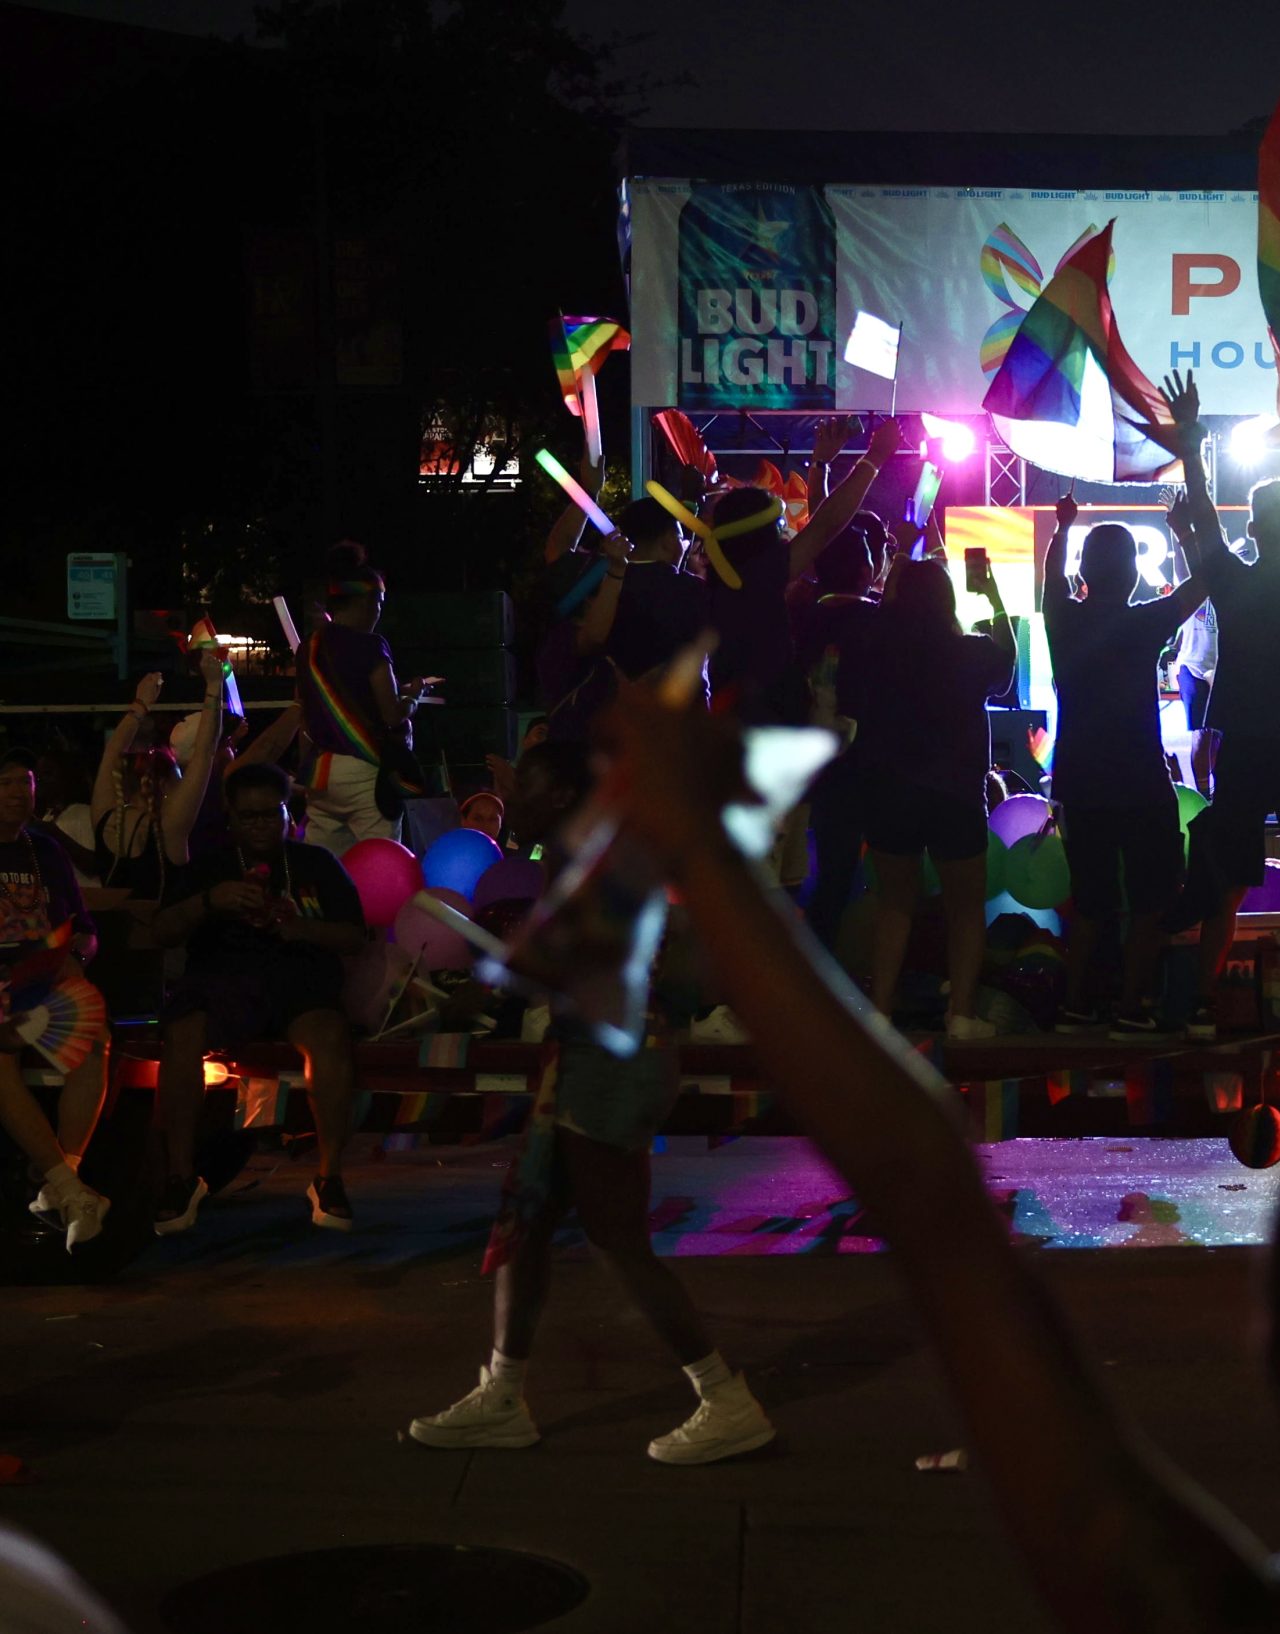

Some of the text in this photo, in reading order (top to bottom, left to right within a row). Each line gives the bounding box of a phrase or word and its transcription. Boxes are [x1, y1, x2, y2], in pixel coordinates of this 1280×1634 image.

[882, 189, 927, 197] BUD LIGHT
[957, 190, 1002, 198] BUD LIGHT
[1030, 191, 1076, 199] BUD LIGHT
[1104, 192, 1150, 200] BUD LIGHT
[1178, 193, 1224, 201] BUD LIGHT
[697, 288, 818, 336] BUD
[681, 337, 833, 386] LIGHT
